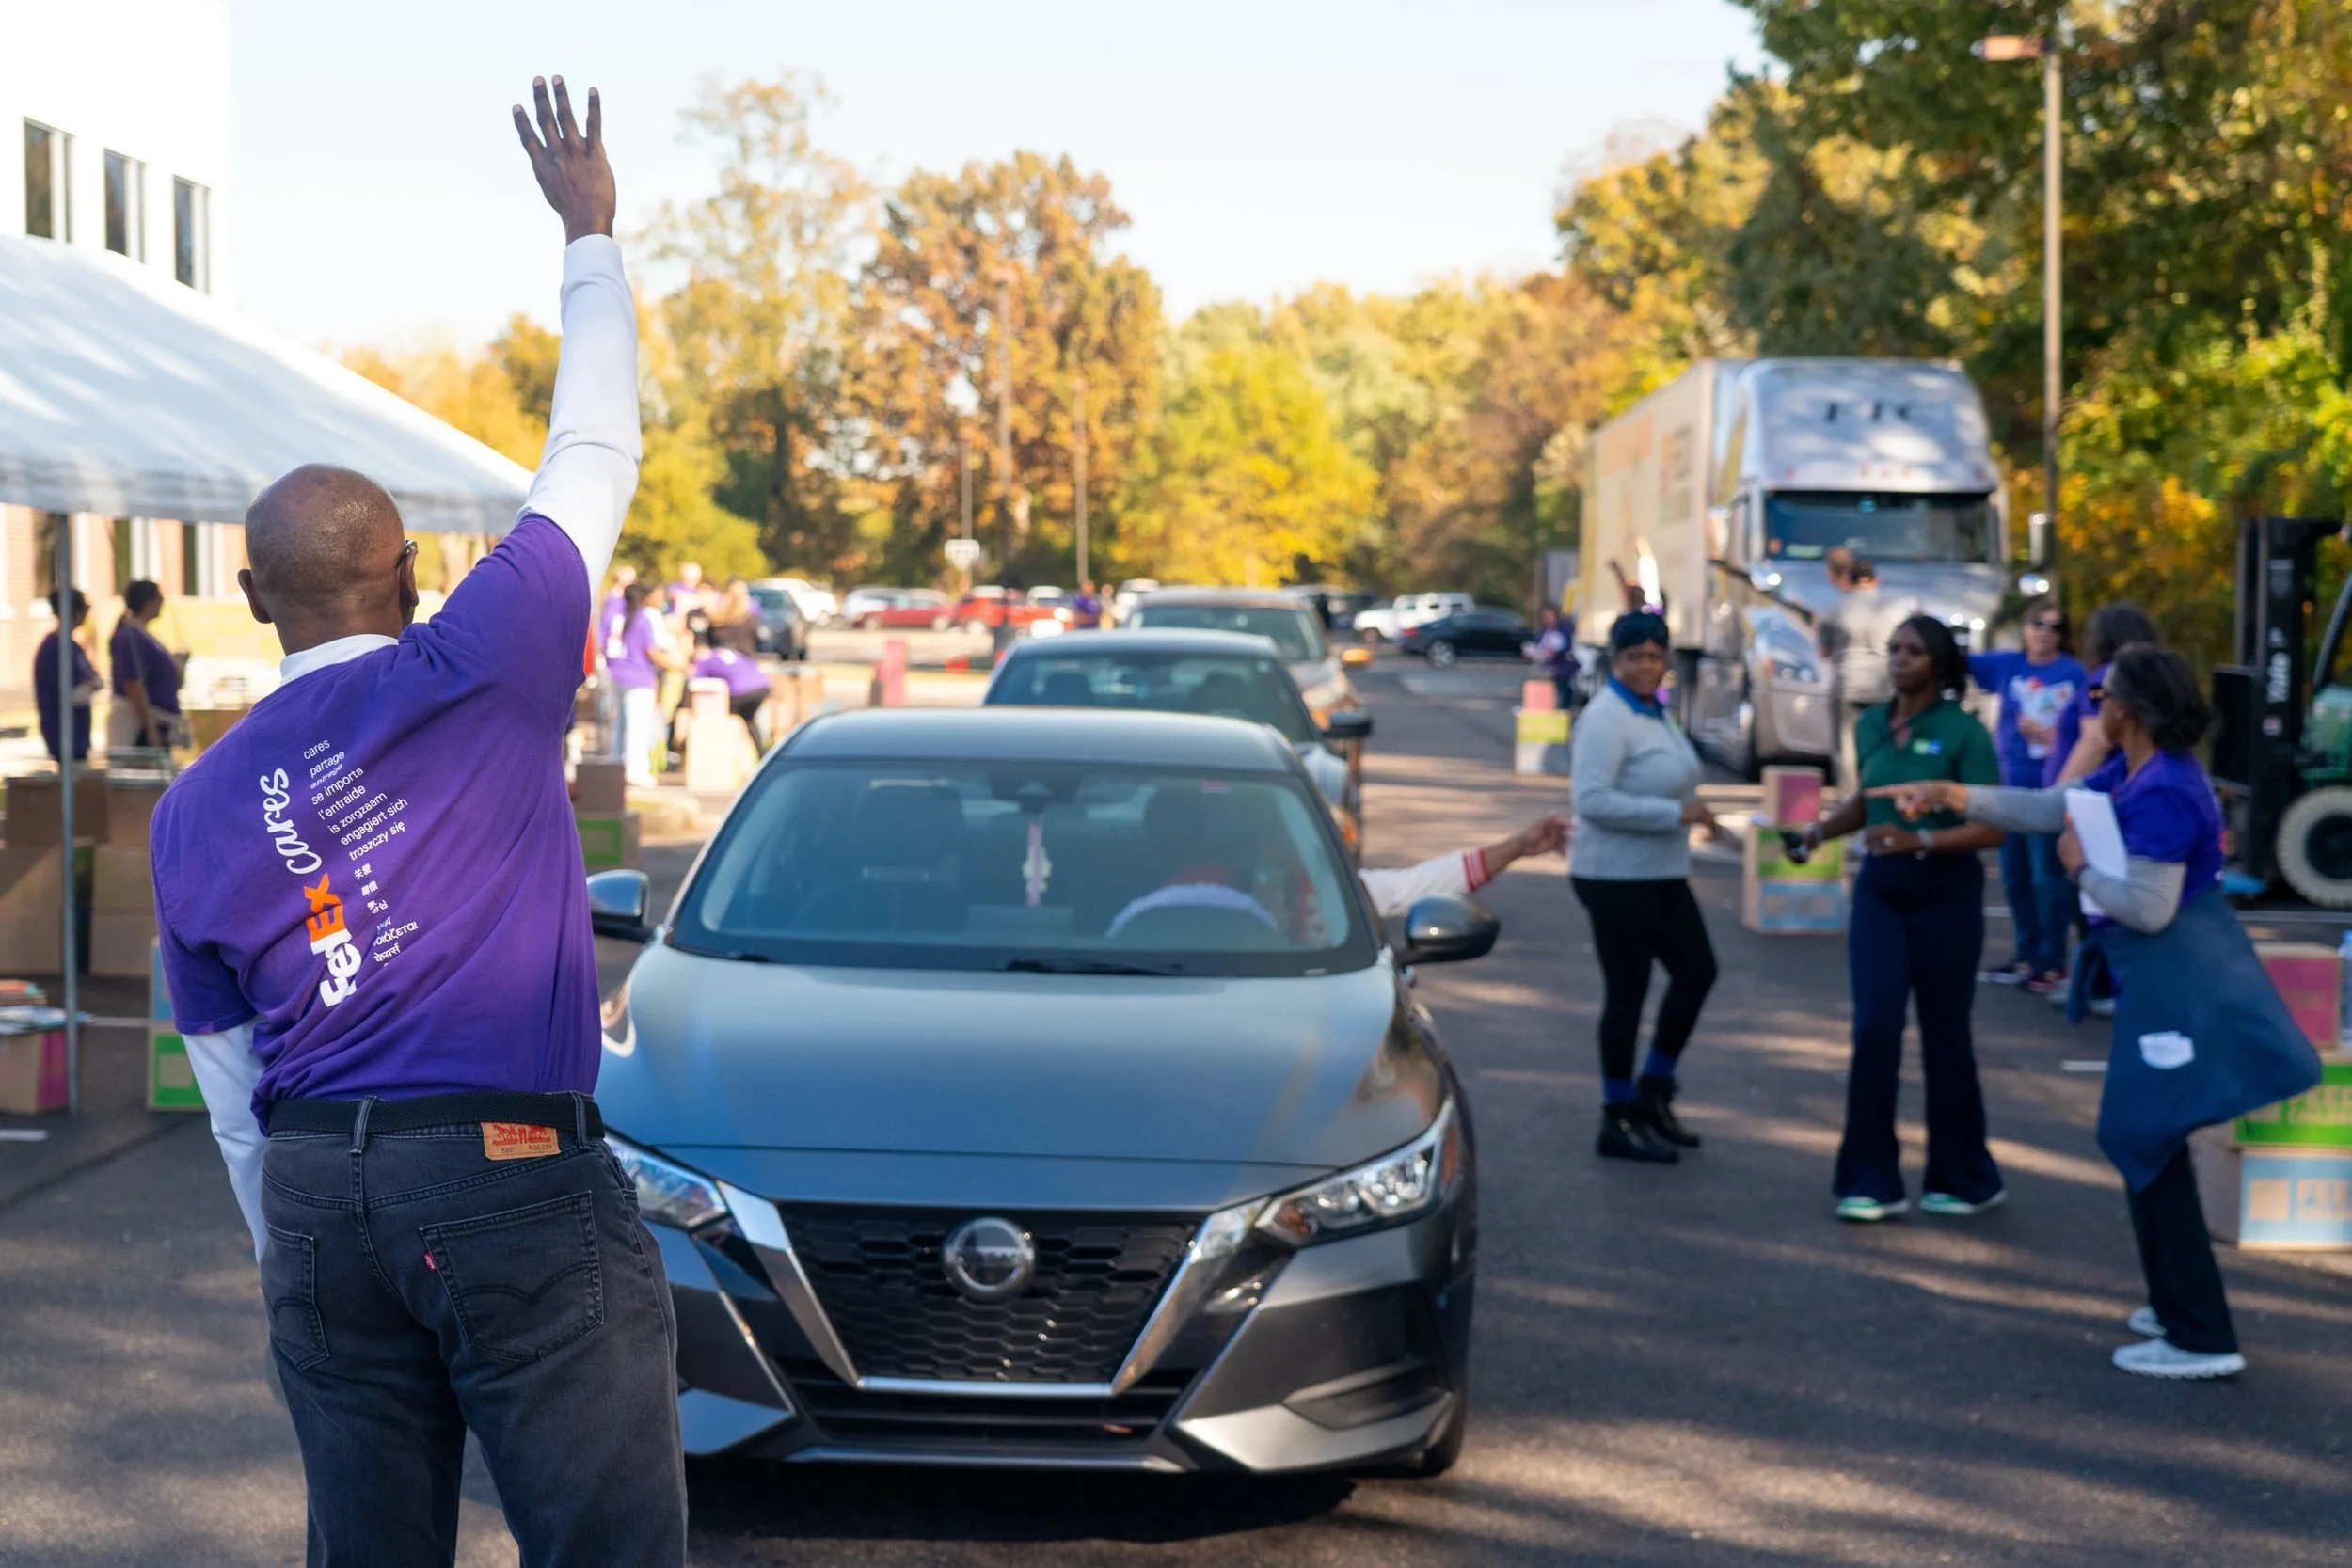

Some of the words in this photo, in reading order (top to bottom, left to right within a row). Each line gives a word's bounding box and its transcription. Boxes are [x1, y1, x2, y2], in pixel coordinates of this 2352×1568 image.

[303, 739, 331, 760] cares
[310, 751, 345, 779] partage
[310, 792, 325, 805] se
[324, 768, 364, 797] importa
[317, 785, 366, 820] l'entraide
[327, 824, 341, 834] is
[340, 792, 388, 828] zorgzaam
[340, 811, 388, 846] engagiert
[387, 798, 408, 816] sich
[348, 831, 389, 861] troszczy
[389, 821, 406, 835] się
[373, 921, 419, 947] οιάζεται
